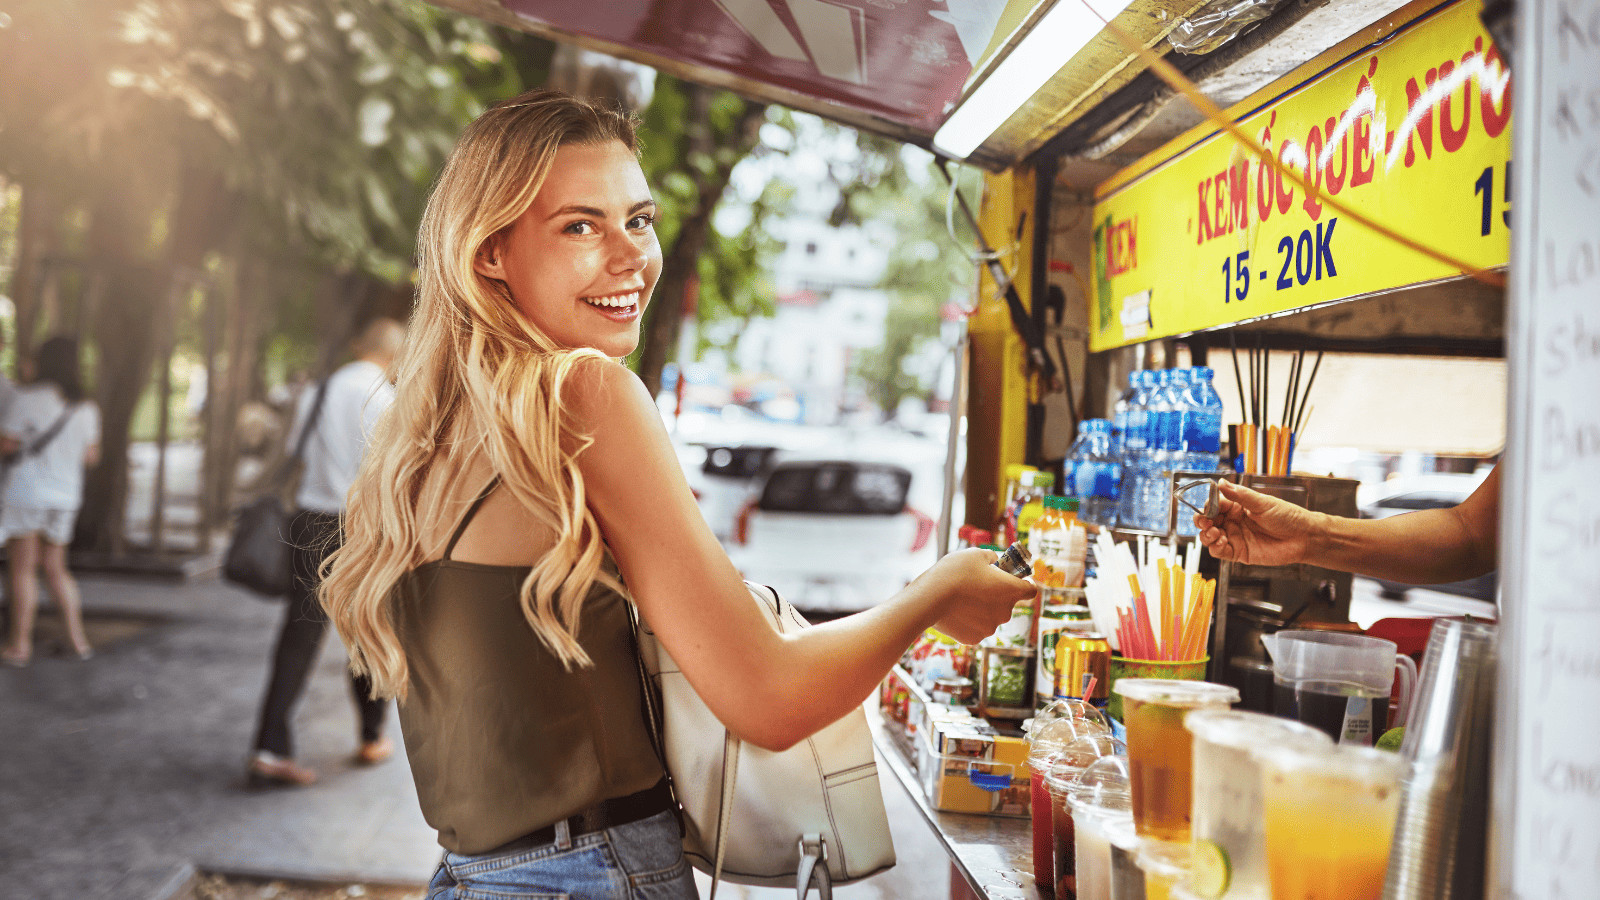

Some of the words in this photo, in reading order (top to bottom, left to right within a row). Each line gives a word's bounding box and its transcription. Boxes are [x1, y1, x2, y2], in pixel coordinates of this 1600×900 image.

[1197, 158, 1250, 245] KEM
[1257, 109, 1294, 222] ỐC
[1302, 56, 1378, 221] QUẾ
[1222, 250, 1250, 303] 15
[1259, 270, 1267, 280] -
[1276, 217, 1338, 291] 20K
